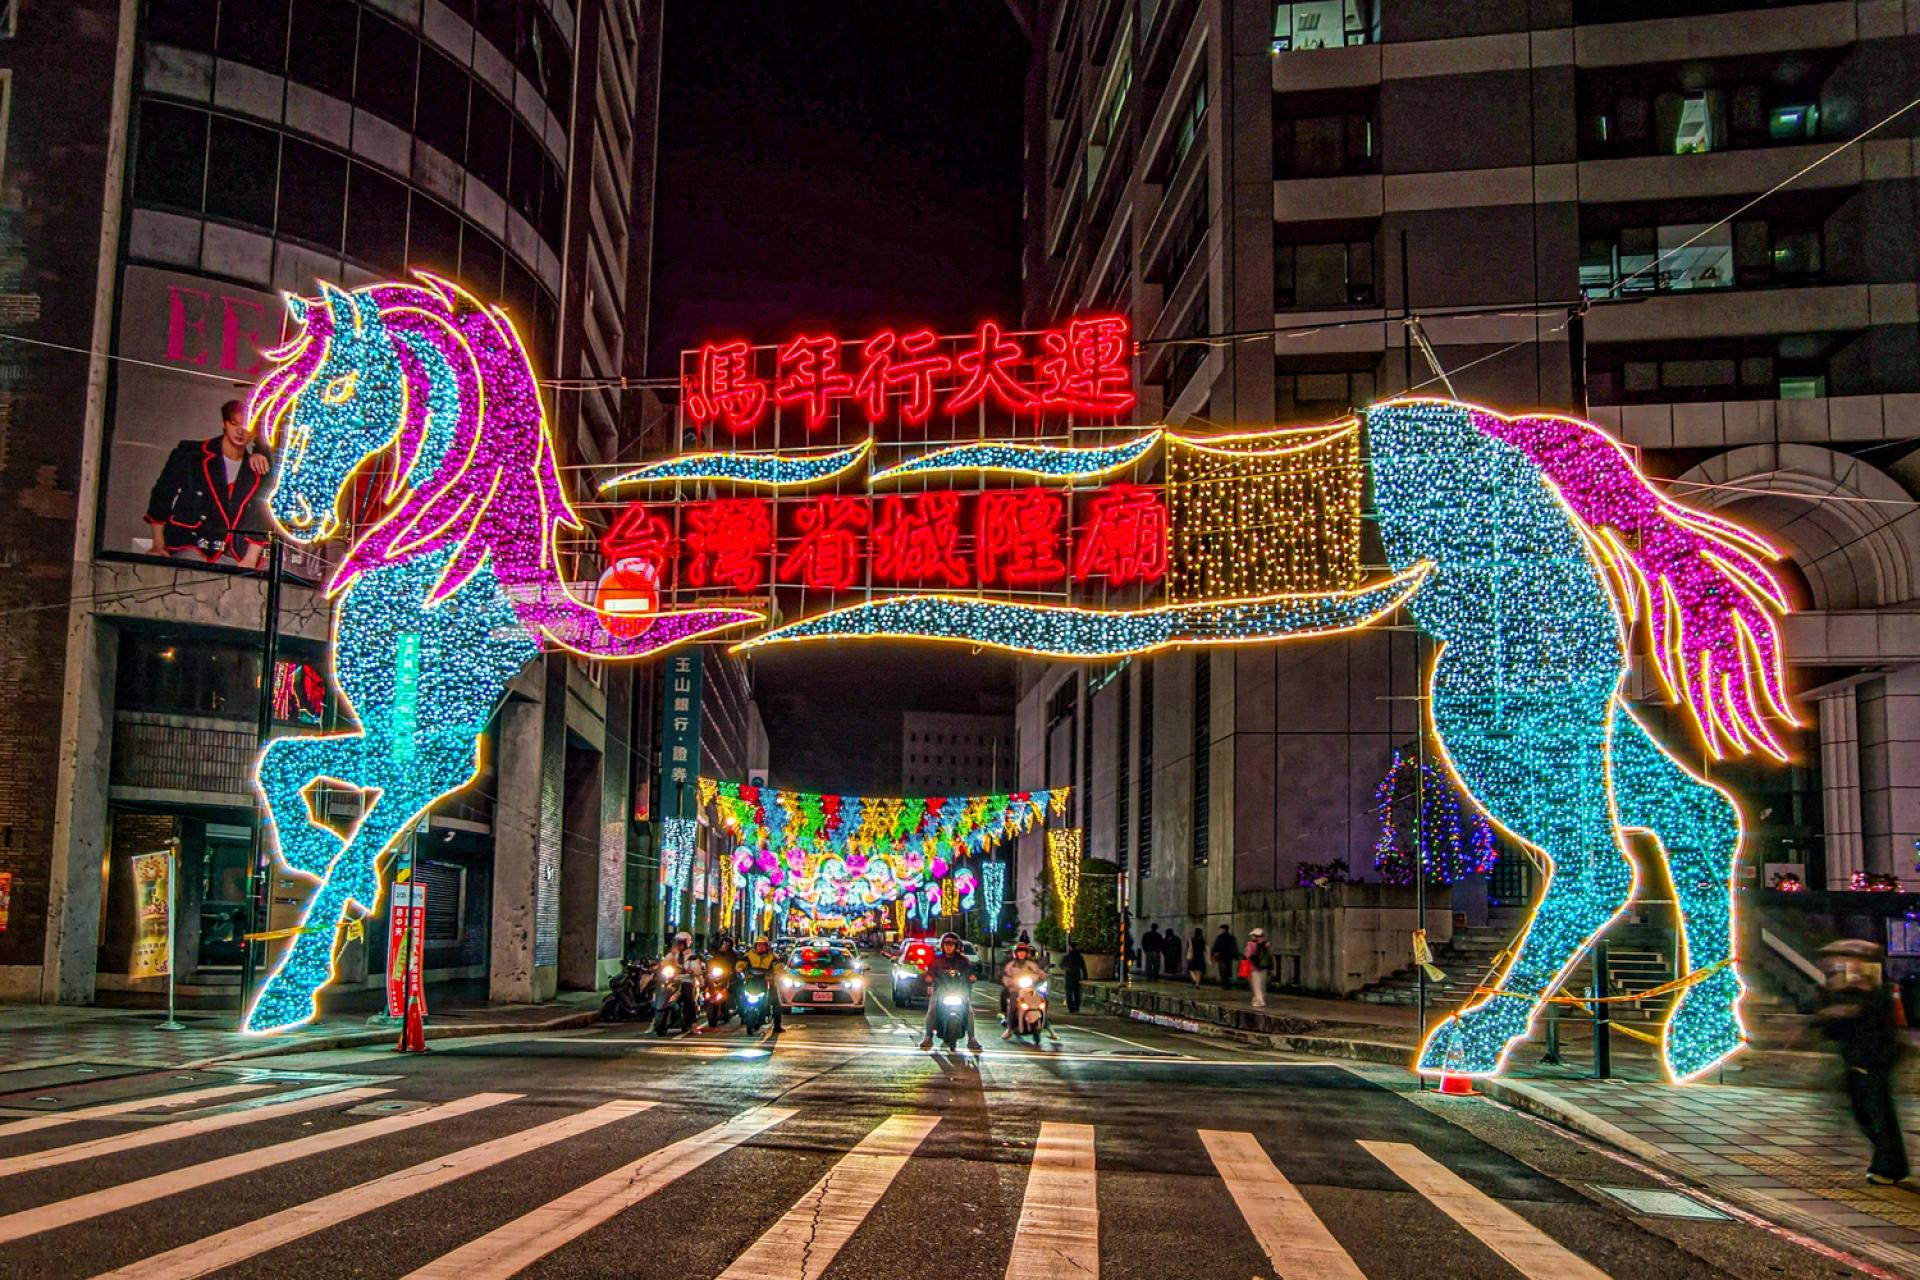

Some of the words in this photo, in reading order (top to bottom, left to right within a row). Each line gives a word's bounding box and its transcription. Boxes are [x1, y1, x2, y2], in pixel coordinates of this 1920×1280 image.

[687, 317, 1136, 428] 馬年行大運
[602, 485, 1169, 592] 台灣省城隍廟
